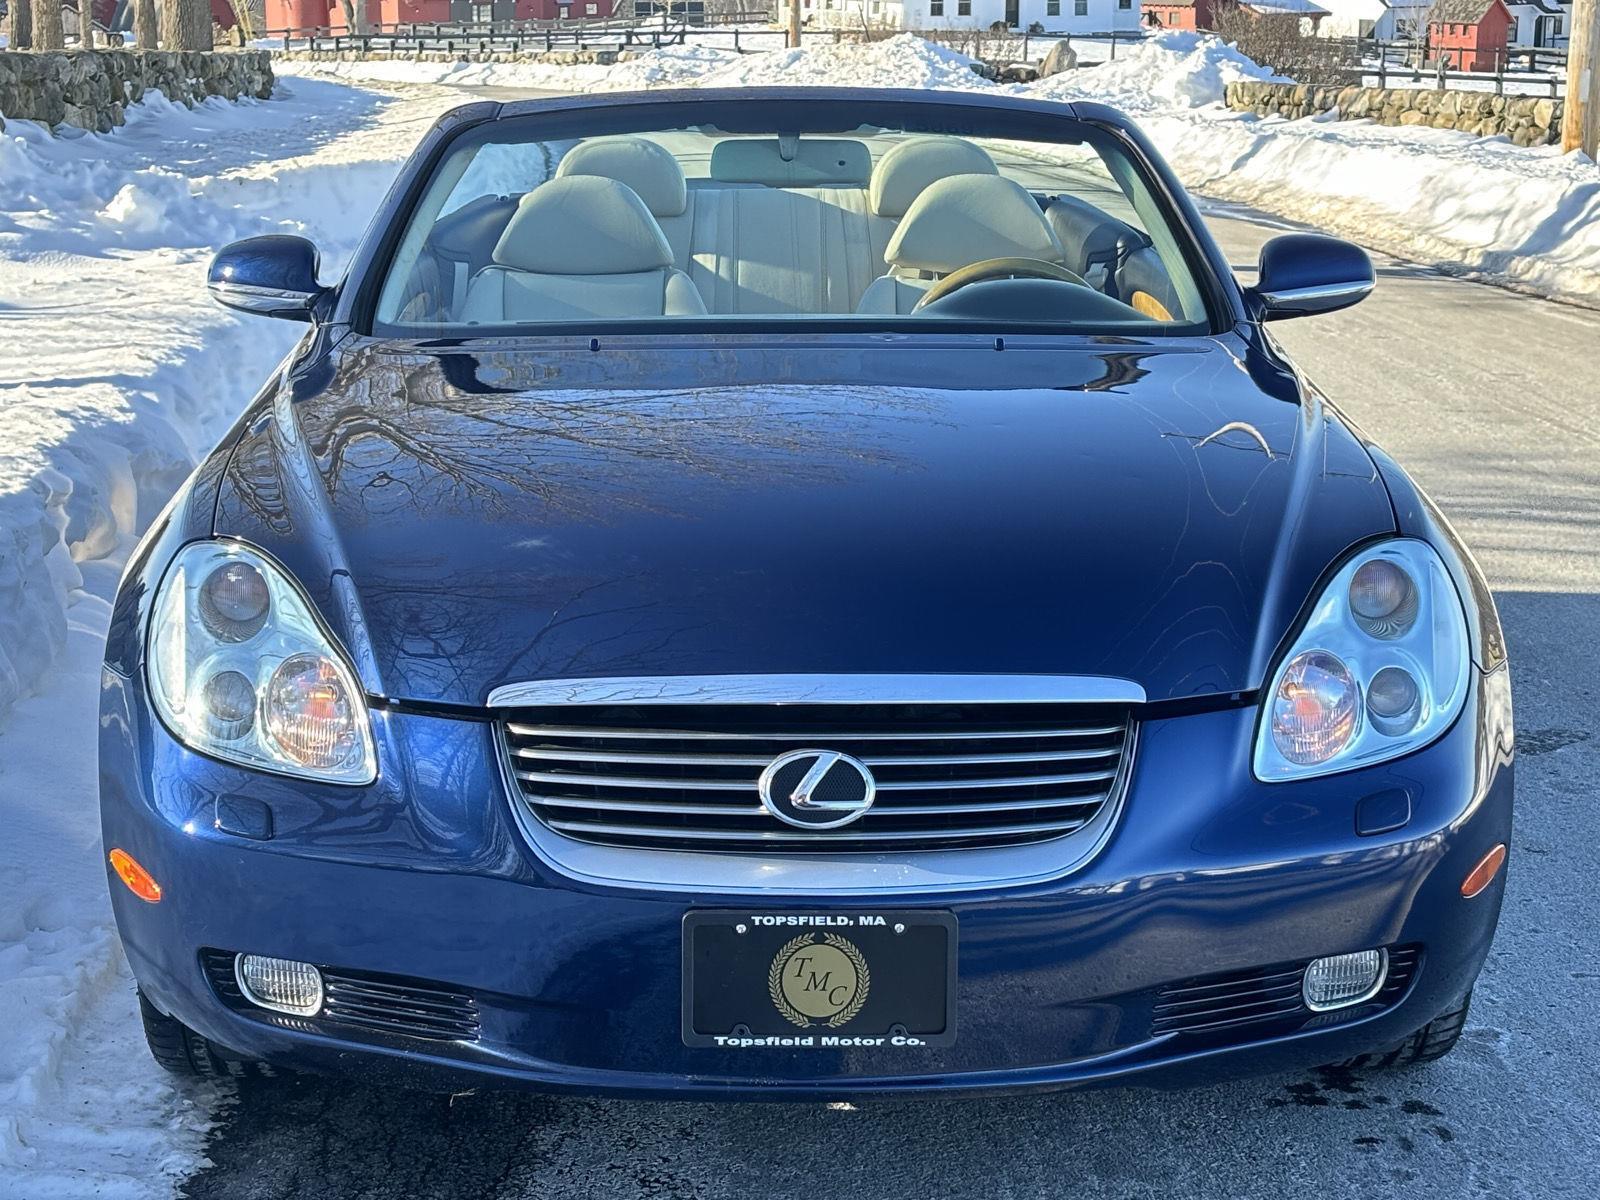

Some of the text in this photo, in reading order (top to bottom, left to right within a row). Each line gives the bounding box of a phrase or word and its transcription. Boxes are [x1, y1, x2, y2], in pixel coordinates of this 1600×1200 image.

[751, 915, 887, 926] TOPSFIELD, MA
[714, 1036, 926, 1047] Topsfield Motor Co.
